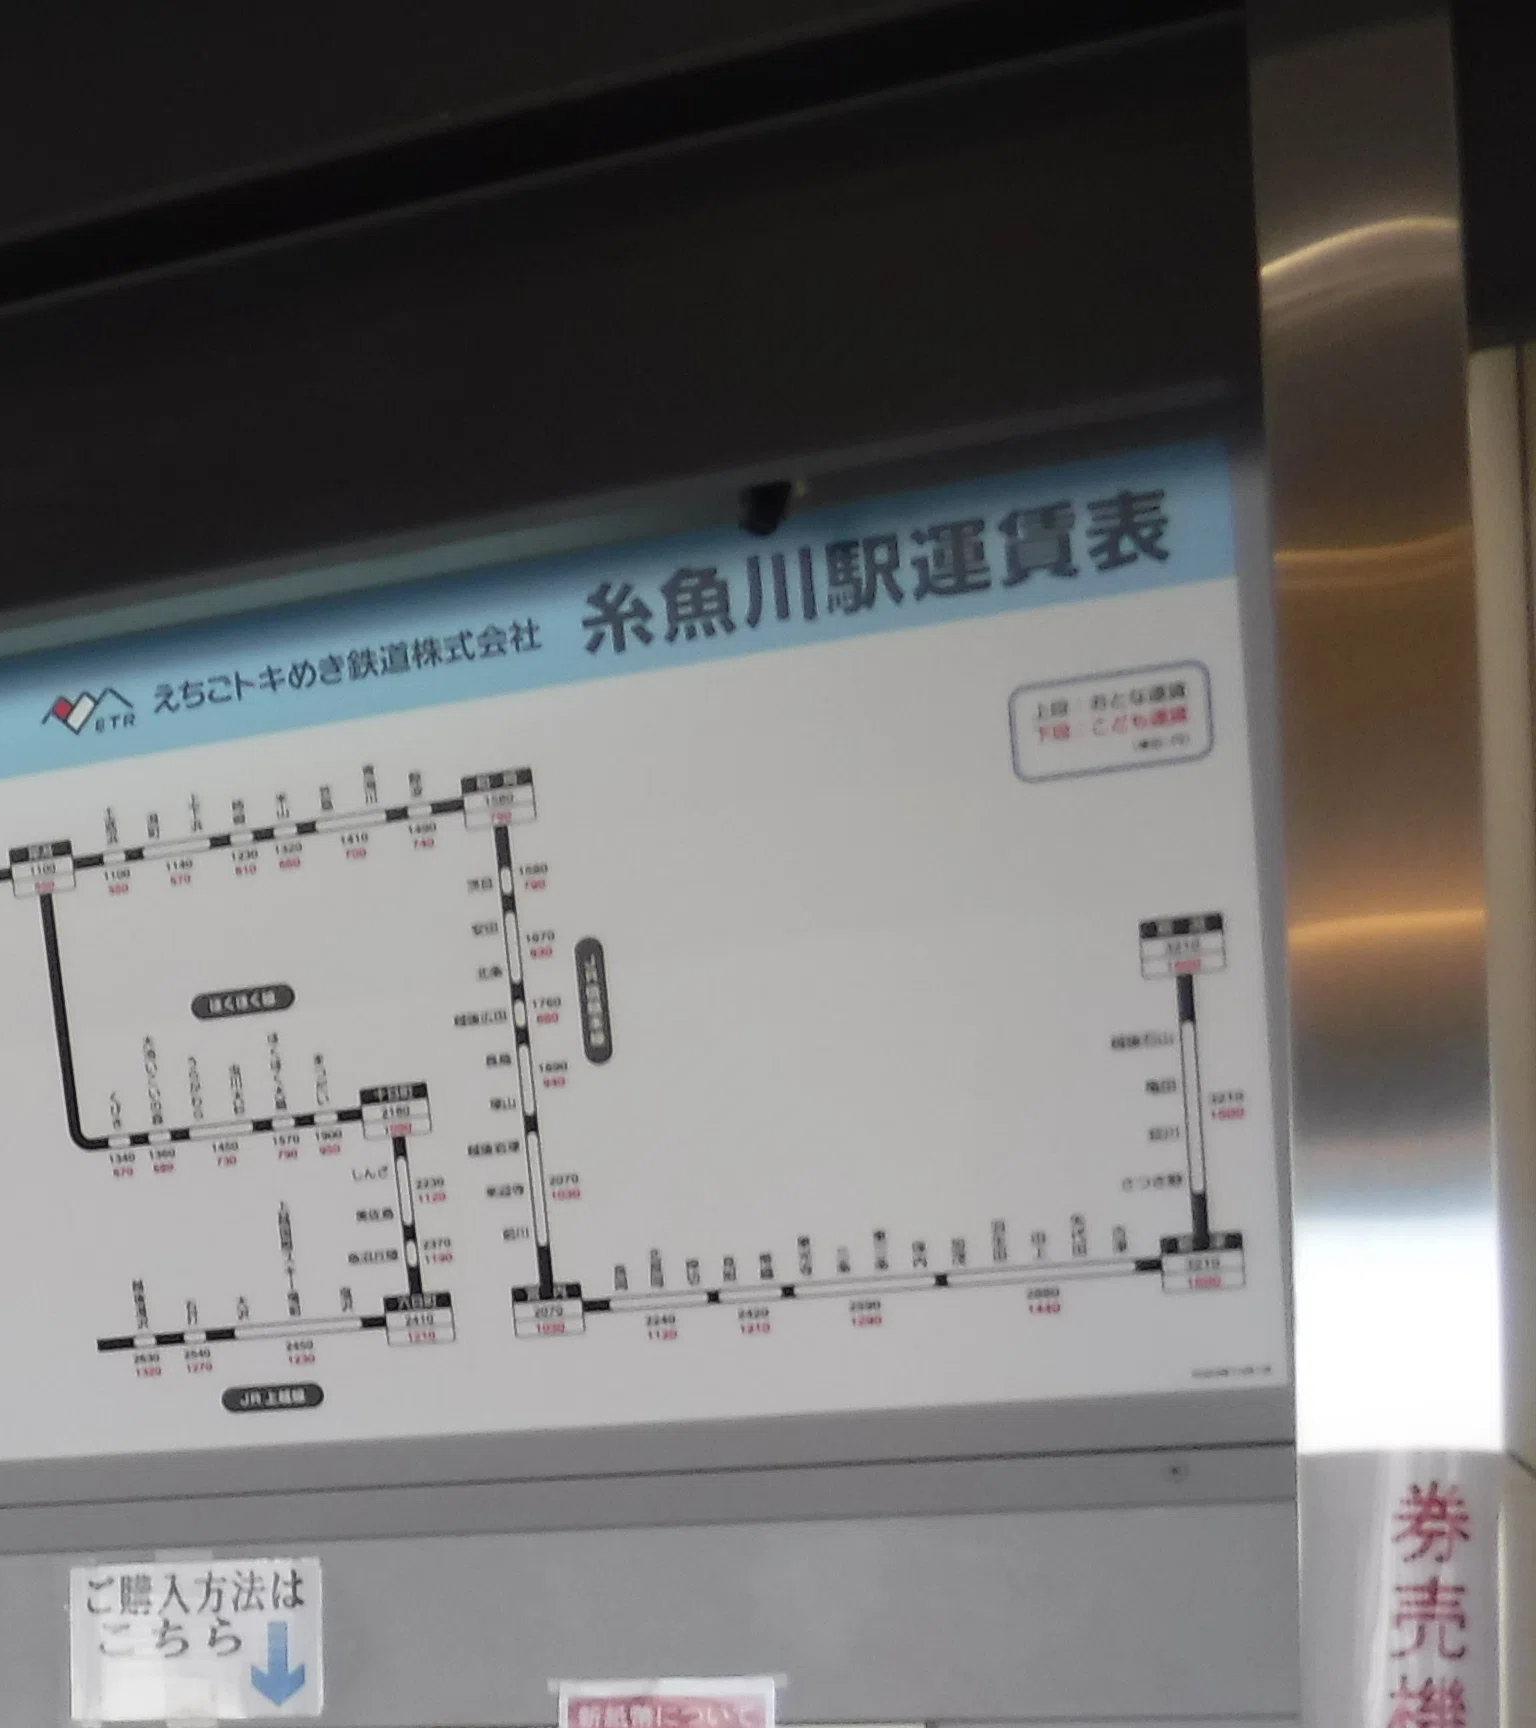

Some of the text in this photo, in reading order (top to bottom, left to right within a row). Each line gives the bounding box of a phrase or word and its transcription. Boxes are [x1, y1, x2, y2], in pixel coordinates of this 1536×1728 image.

[152, 488, 1172, 716] えちごトキめき鉄道株式会社 糸魚川駅運賃表
[86, 1569, 306, 1615] ご購入方法は
[99, 1617, 243, 1658] こちら
